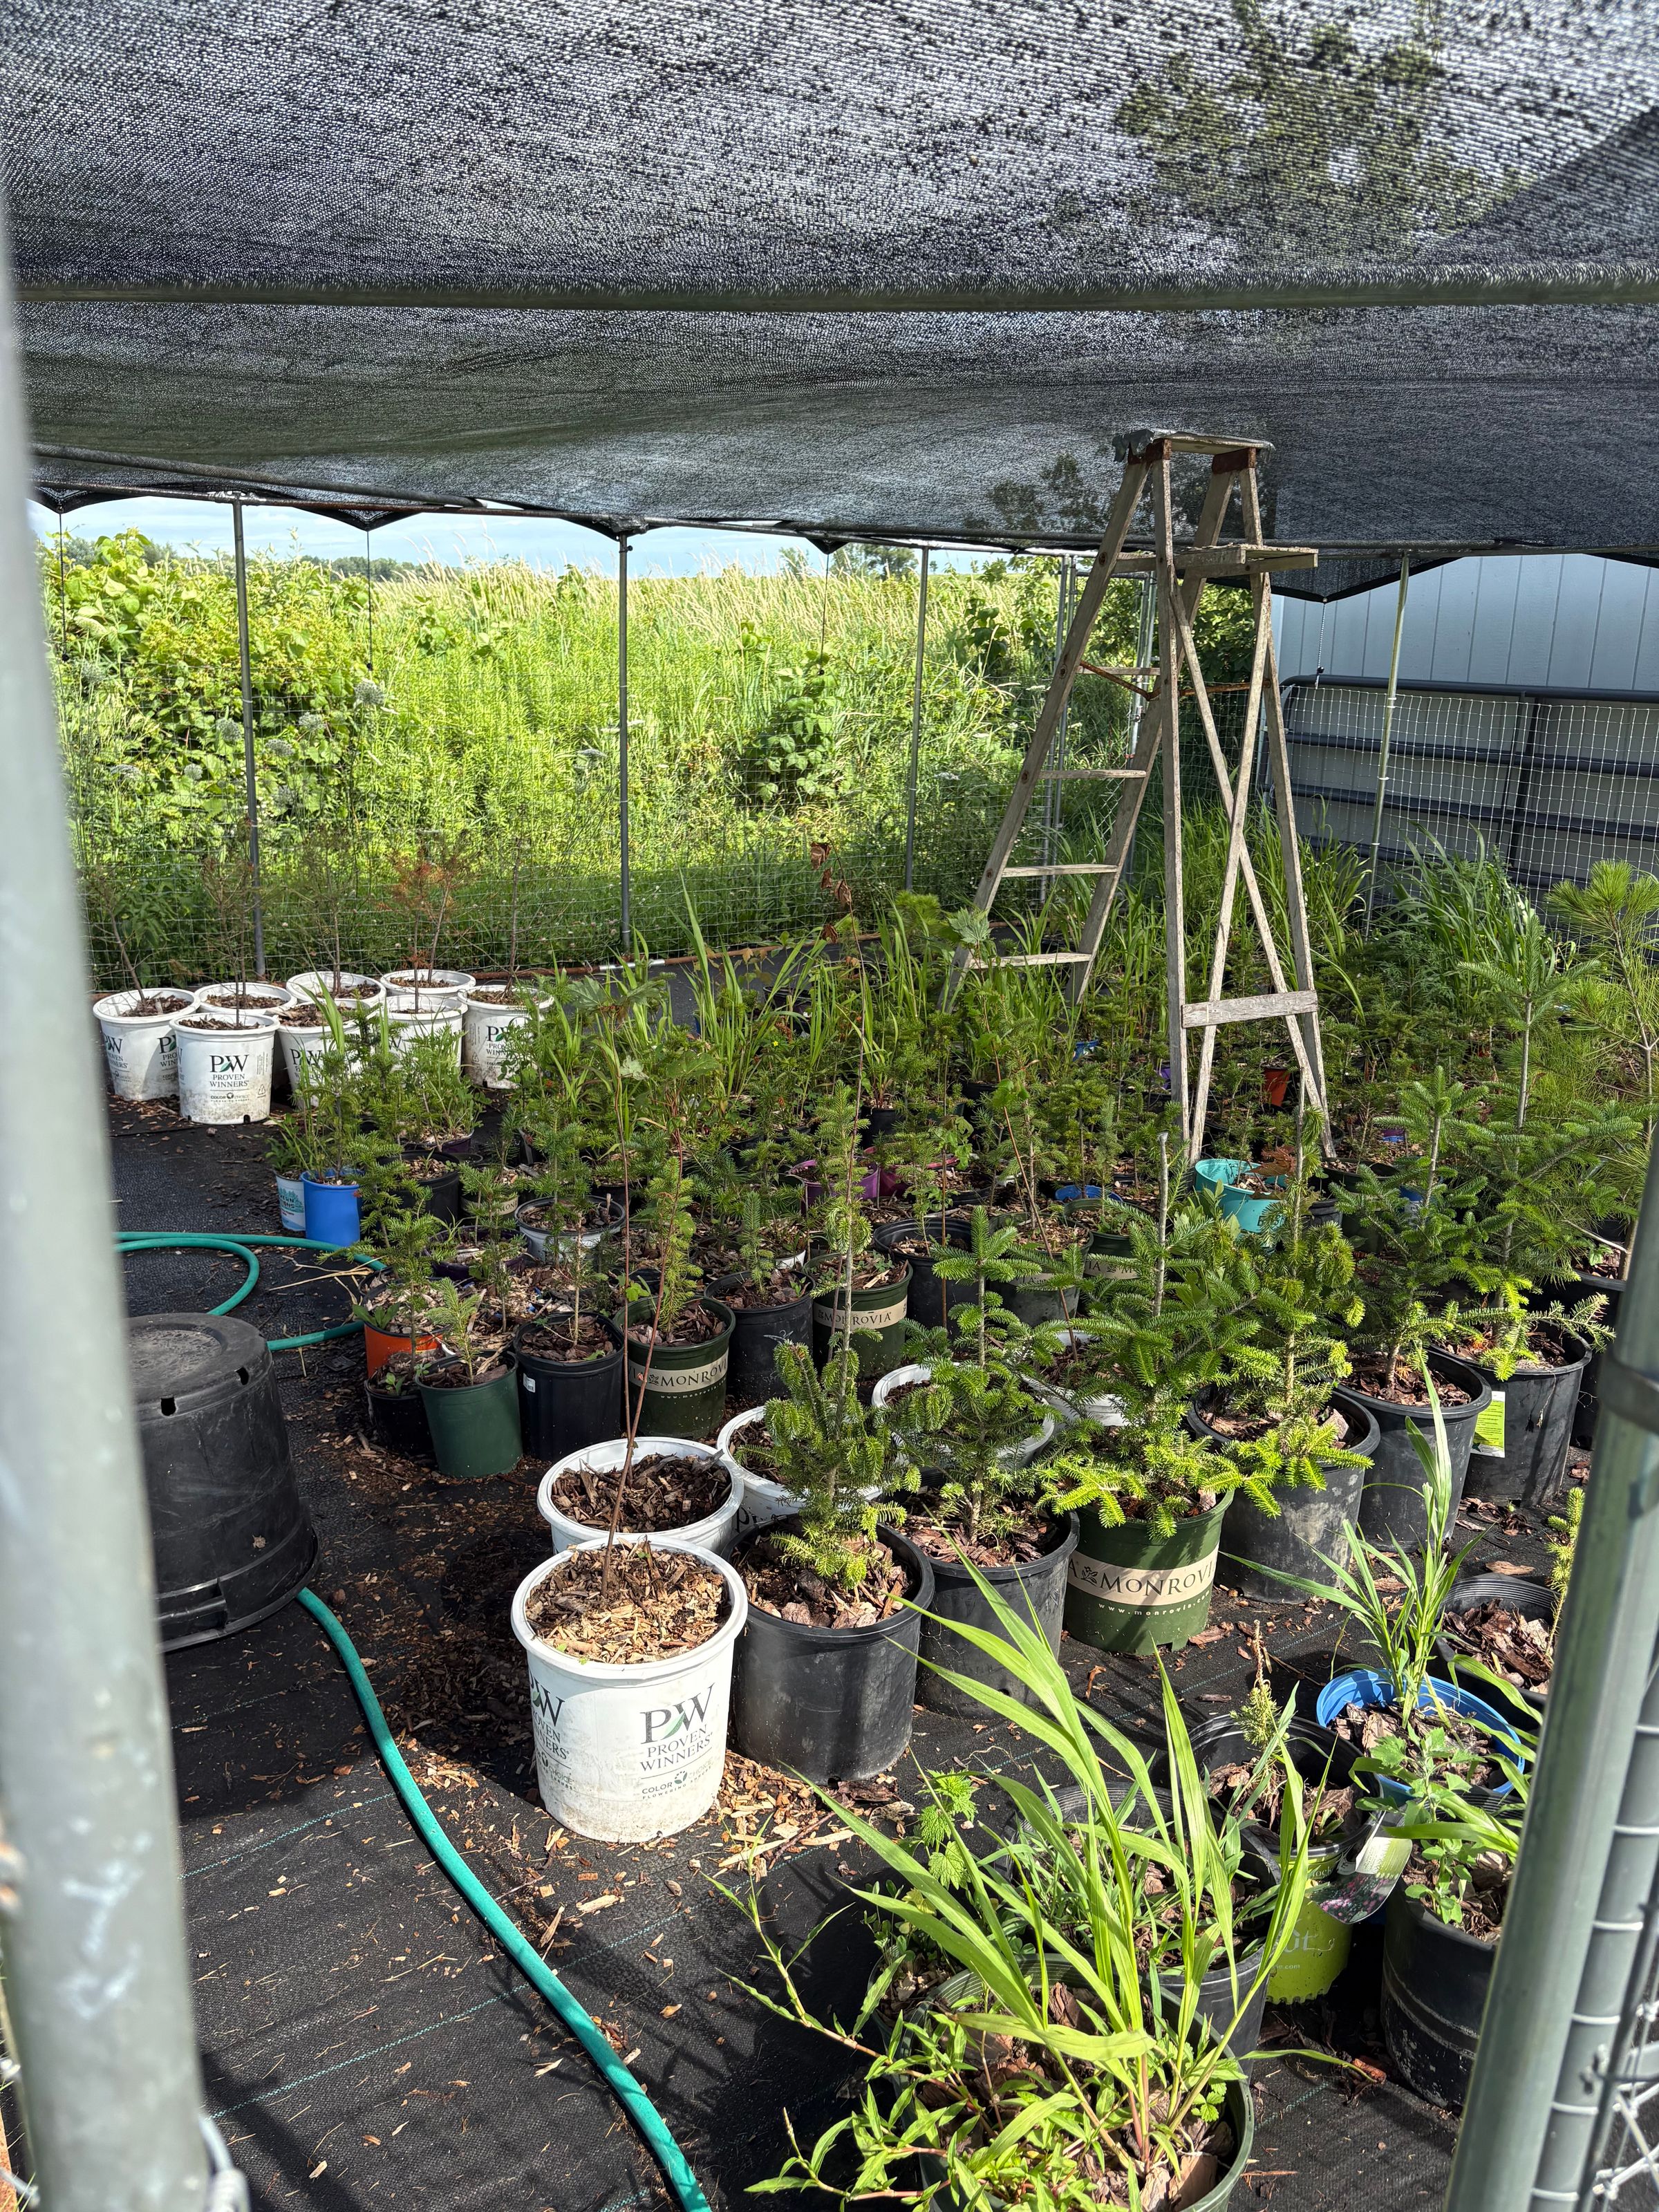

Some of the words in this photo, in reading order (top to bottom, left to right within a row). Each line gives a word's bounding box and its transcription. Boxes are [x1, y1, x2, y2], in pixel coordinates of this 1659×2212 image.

[157, 1034, 177, 1054] P
[209, 1054, 250, 1072] PW
[661, 1358, 727, 1387] MONROVI
[1100, 1561, 1214, 1596] MONROVI
[639, 1683, 715, 1745] PW
[639, 1734, 712, 1772] WINNERS
[648, 1724, 707, 1758] PROVEN
[641, 1781, 673, 1794] COLOR
